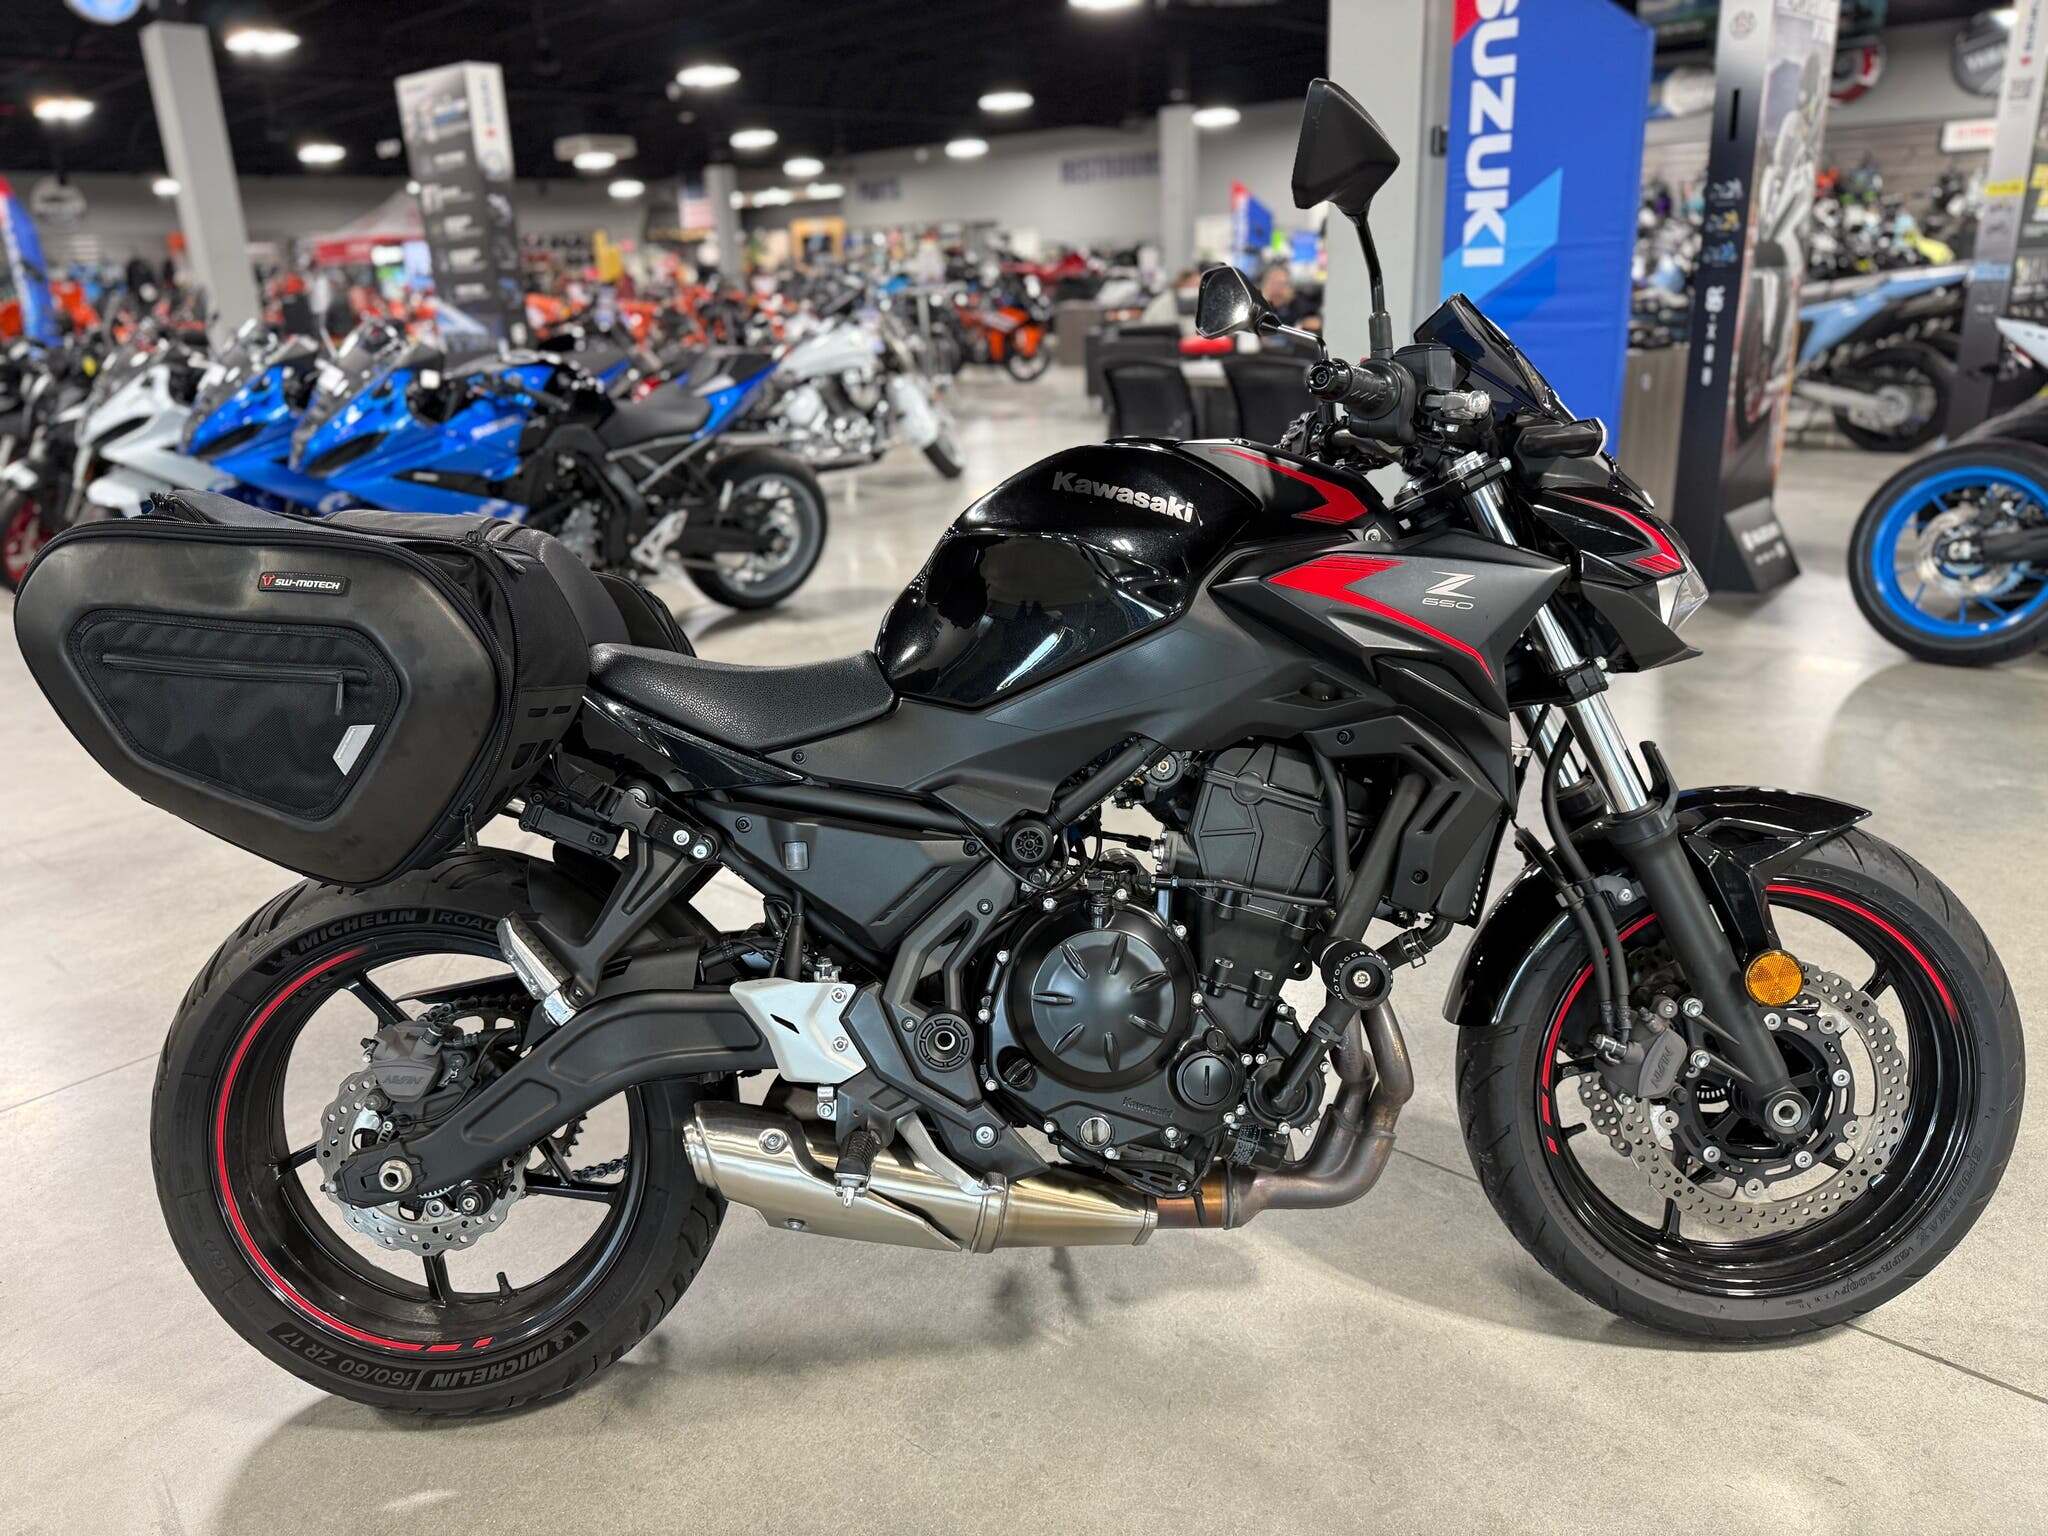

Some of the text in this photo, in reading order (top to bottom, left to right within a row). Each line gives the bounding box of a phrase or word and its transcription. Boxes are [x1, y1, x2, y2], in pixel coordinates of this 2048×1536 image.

[1052, 471, 1194, 523] Kawasaki
[274, 578, 341, 590] SW-MOTECH
[1425, 570, 1476, 598] Z
[1422, 597, 1473, 610] 650
[297, 909, 418, 951] MICHELIN
[278, 1329, 549, 1387] MICHELIN 160/60 ZR 17
